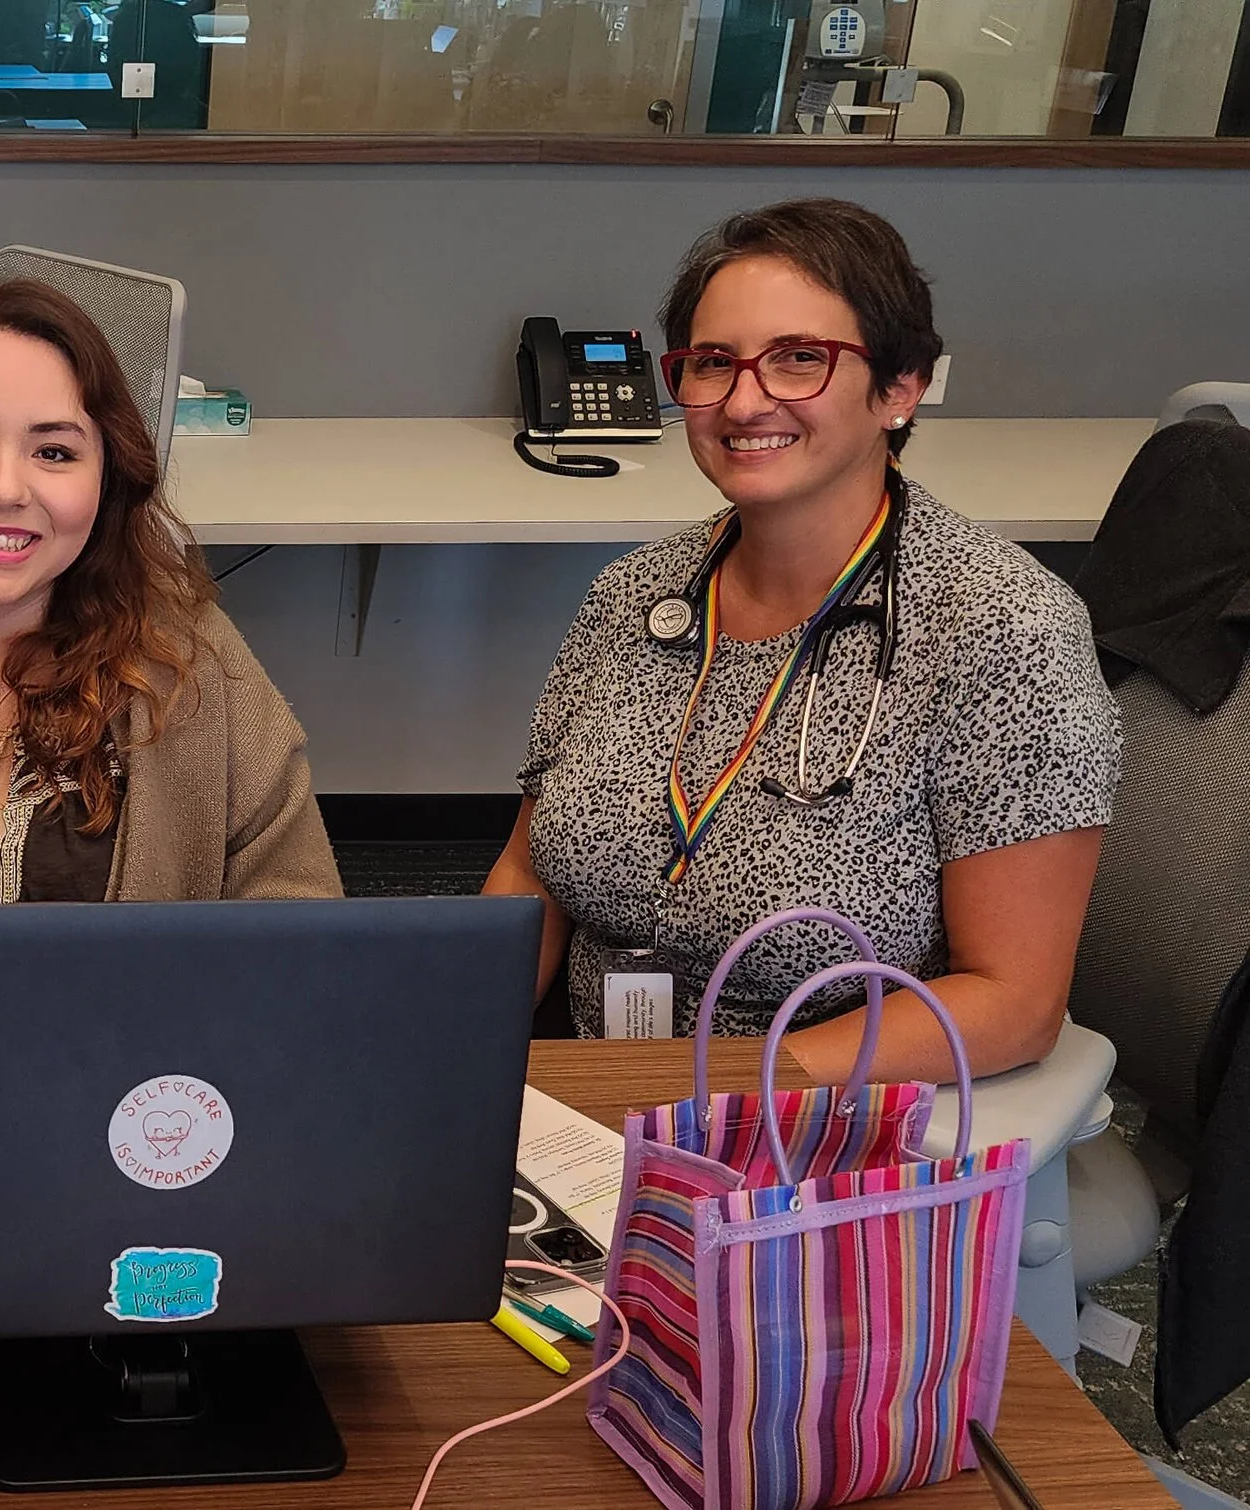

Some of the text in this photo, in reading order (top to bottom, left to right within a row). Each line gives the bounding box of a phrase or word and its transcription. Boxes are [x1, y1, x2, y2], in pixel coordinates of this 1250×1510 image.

[121, 1081, 222, 1121] SELF CARE
[115, 1142, 220, 1184] IS IMPORTANT
